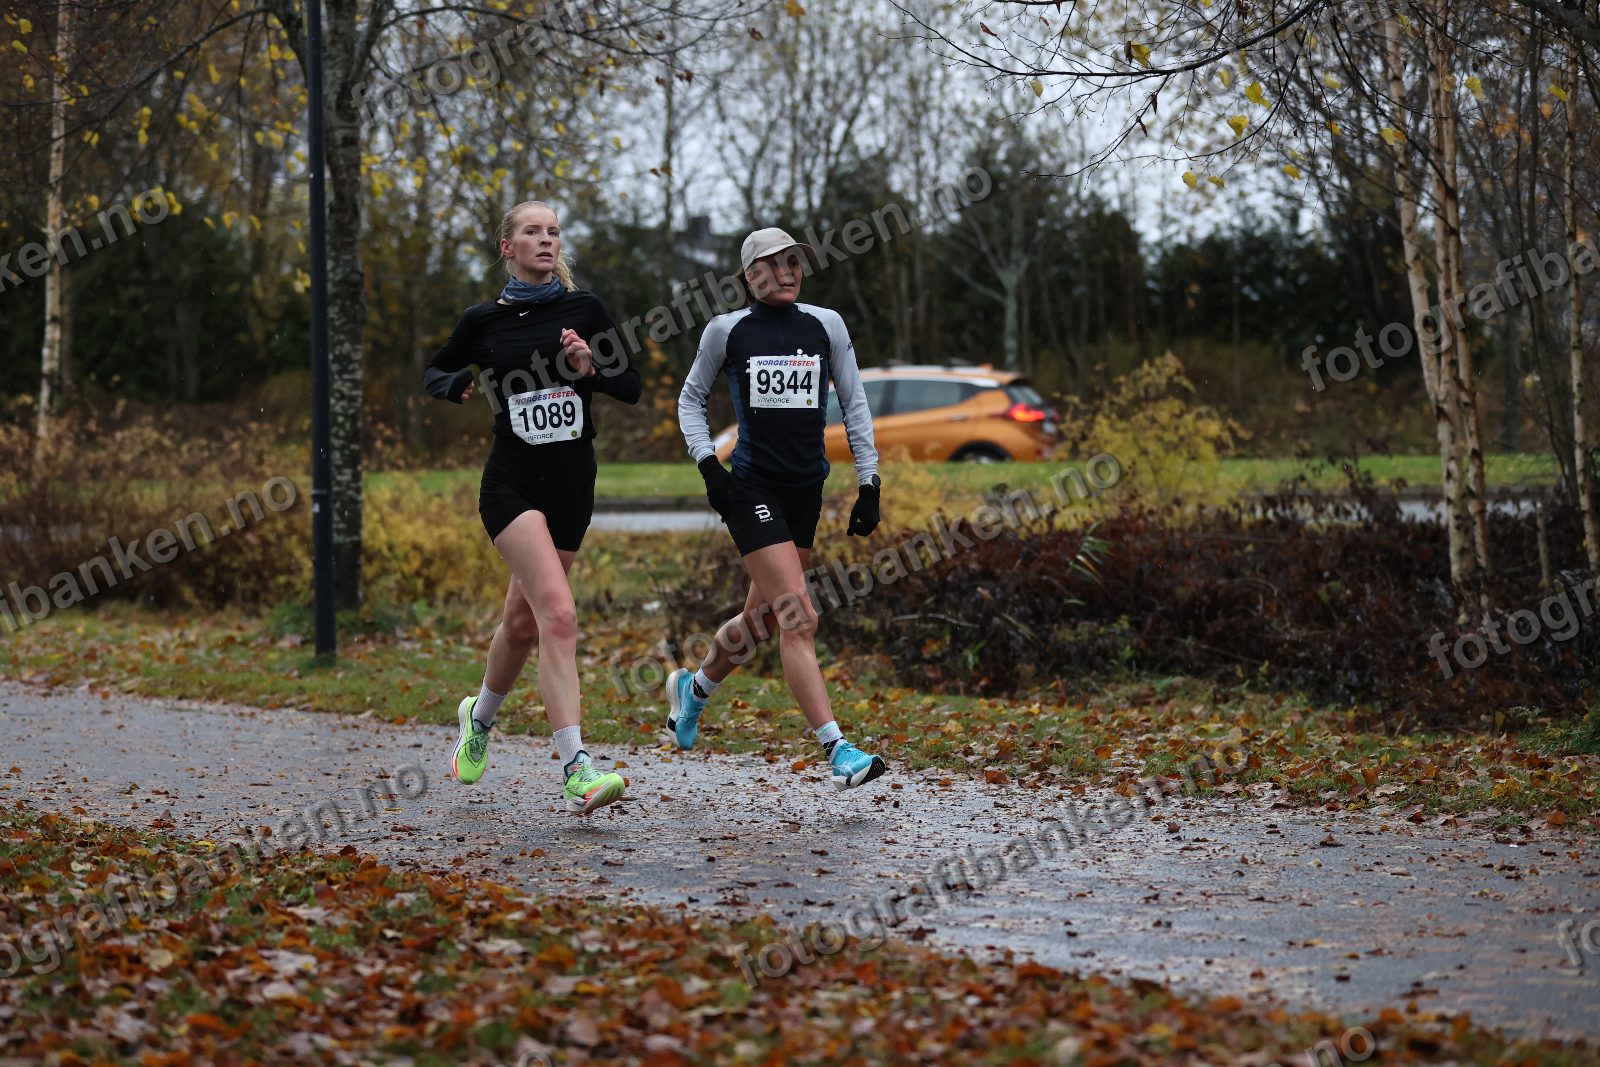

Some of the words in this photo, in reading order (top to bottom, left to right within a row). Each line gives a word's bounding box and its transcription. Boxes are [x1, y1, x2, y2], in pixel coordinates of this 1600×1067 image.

[757, 359, 816, 367] NORGESTESTEN
[757, 369, 813, 395] 9344
[515, 391, 577, 406] NORGESTESTEN
[518, 400, 576, 432] 1089
